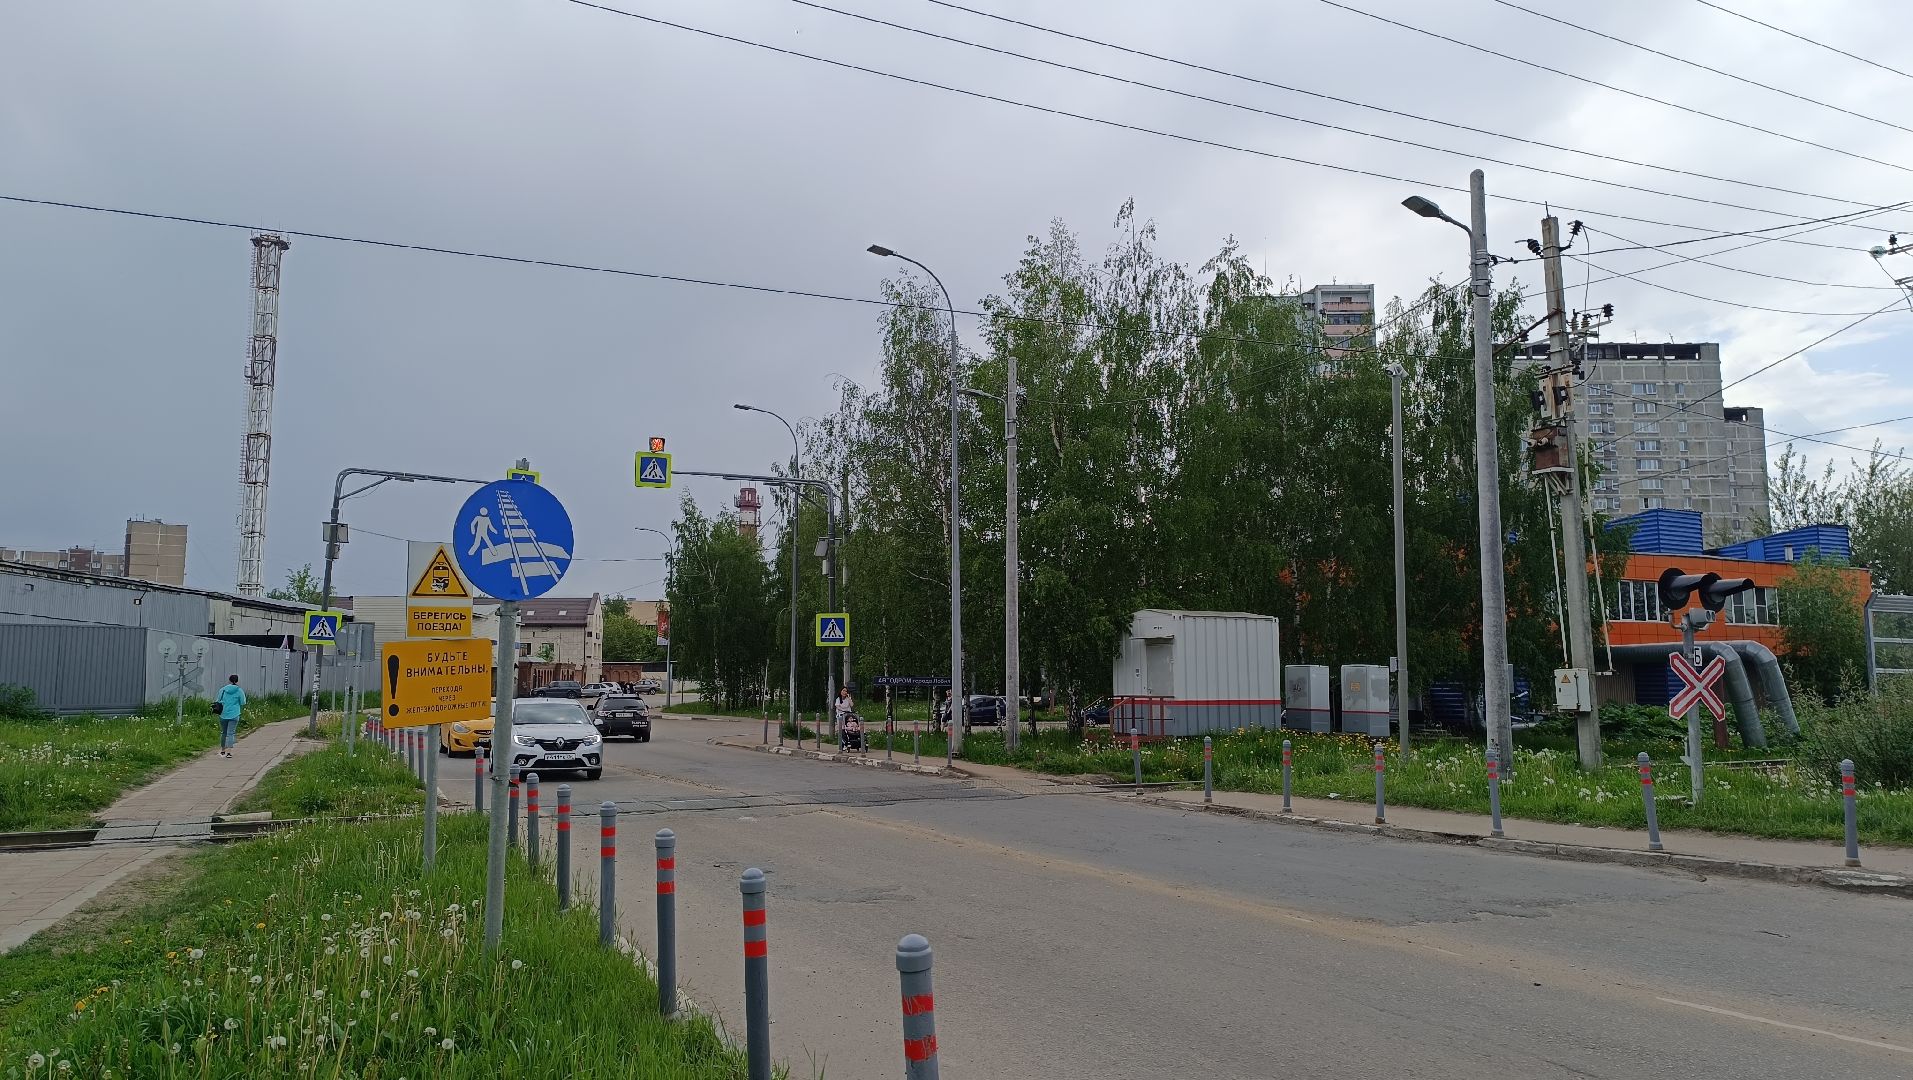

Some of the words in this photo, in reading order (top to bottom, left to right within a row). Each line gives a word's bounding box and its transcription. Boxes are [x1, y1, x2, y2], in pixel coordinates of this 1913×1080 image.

[413, 612, 467, 620] БЕРЕГИСЬ
[417, 623, 461, 632] ПОЕЗДА!
[427, 651, 468, 663] БУДЬТЕ
[431, 685, 462, 693] ПЕРЕХОДЯ
[438, 694, 456, 702] ЧЕРЕЗ
[406, 702, 469, 714] ЖЕЛЕЗНОДОРОЖНЫЕ
